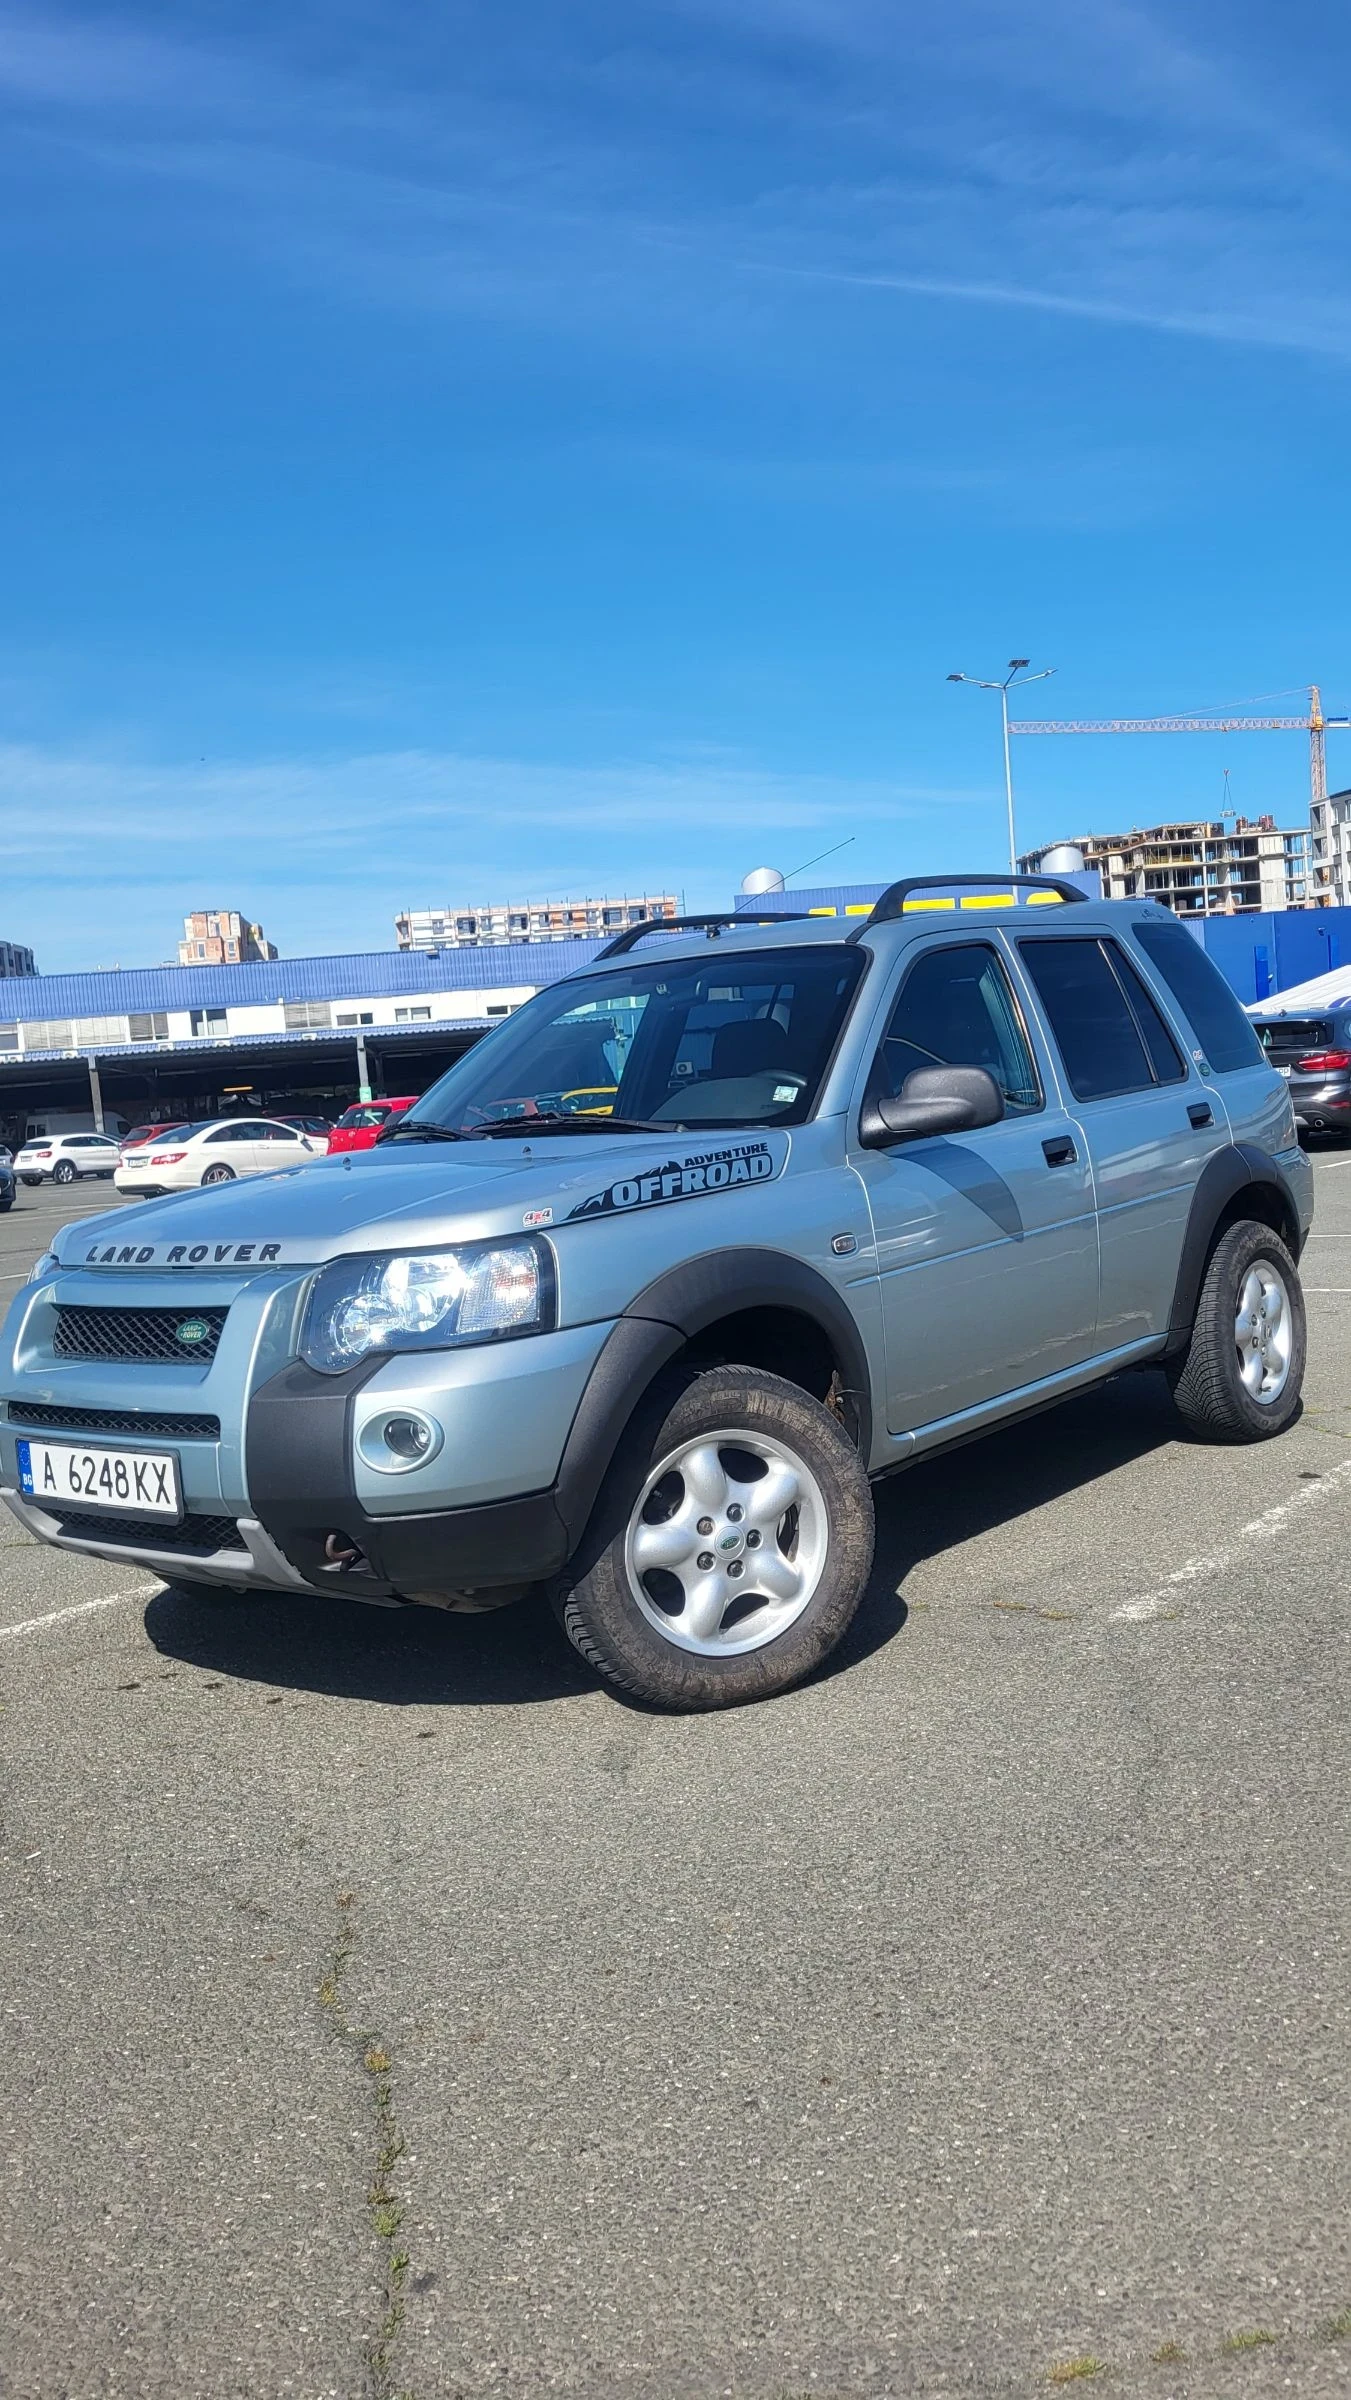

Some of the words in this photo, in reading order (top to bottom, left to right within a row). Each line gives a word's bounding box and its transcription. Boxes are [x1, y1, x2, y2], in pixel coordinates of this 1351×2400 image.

[684, 1142, 769, 1167] ADVENTURE
[612, 1155, 771, 1207] OFFROAD
[85, 1246, 155, 1263] LAND
[166, 1243, 282, 1263] ROVER
[182, 1331, 202, 1339] ROVER
[22, 1472, 33, 1486] BG
